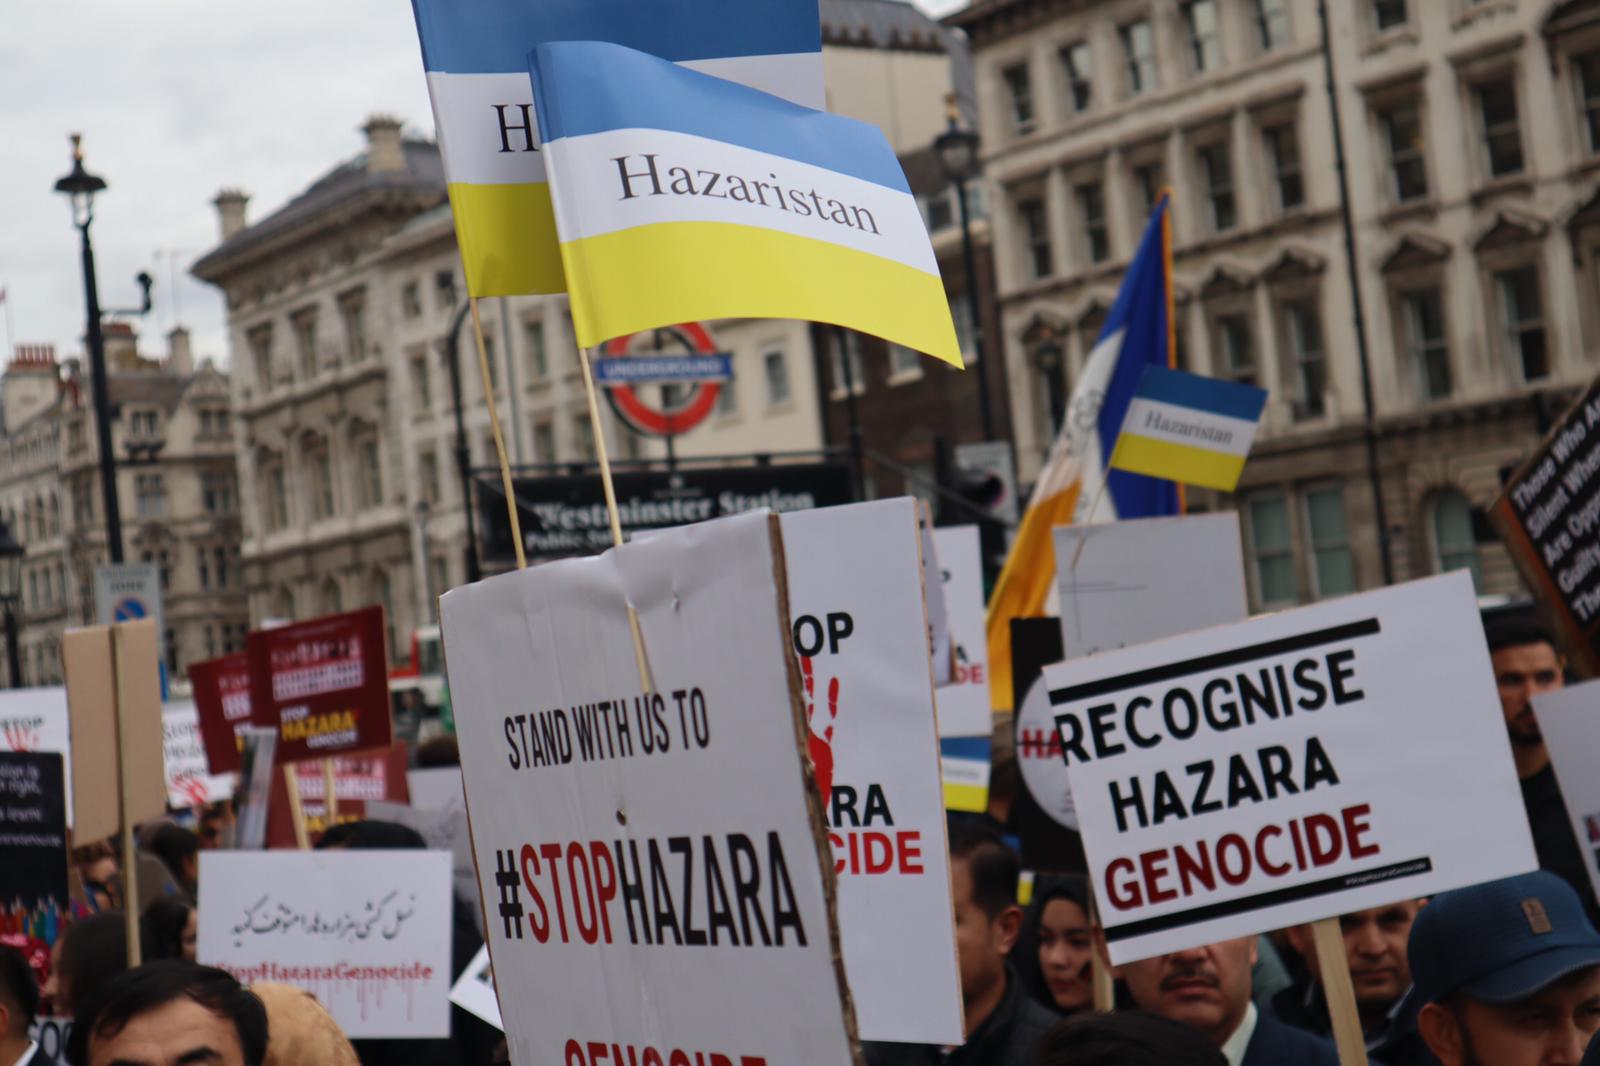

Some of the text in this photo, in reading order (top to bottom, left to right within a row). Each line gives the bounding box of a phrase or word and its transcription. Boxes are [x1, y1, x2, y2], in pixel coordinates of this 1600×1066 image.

[609, 153, 882, 237] Hazaristan
[603, 355, 722, 377] UNDERGROUND
[1144, 410, 1234, 446] Hazaristan
[1513, 457, 1556, 511] Those
[1553, 421, 1587, 463] Who
[535, 497, 713, 531] Westminster
[1526, 485, 1569, 539] Silent
[1543, 530, 1573, 565] Are
[281, 711, 356, 742] HAZARA
[504, 686, 710, 770] STAND WITH US TO
[1055, 648, 1365, 766] RECOGNISE
[824, 784, 895, 829] RA
[1108, 736, 1340, 833] HAZARA
[495, 830, 808, 948] #STOPHAZARA
[1104, 803, 1380, 912] GENOCIDE
